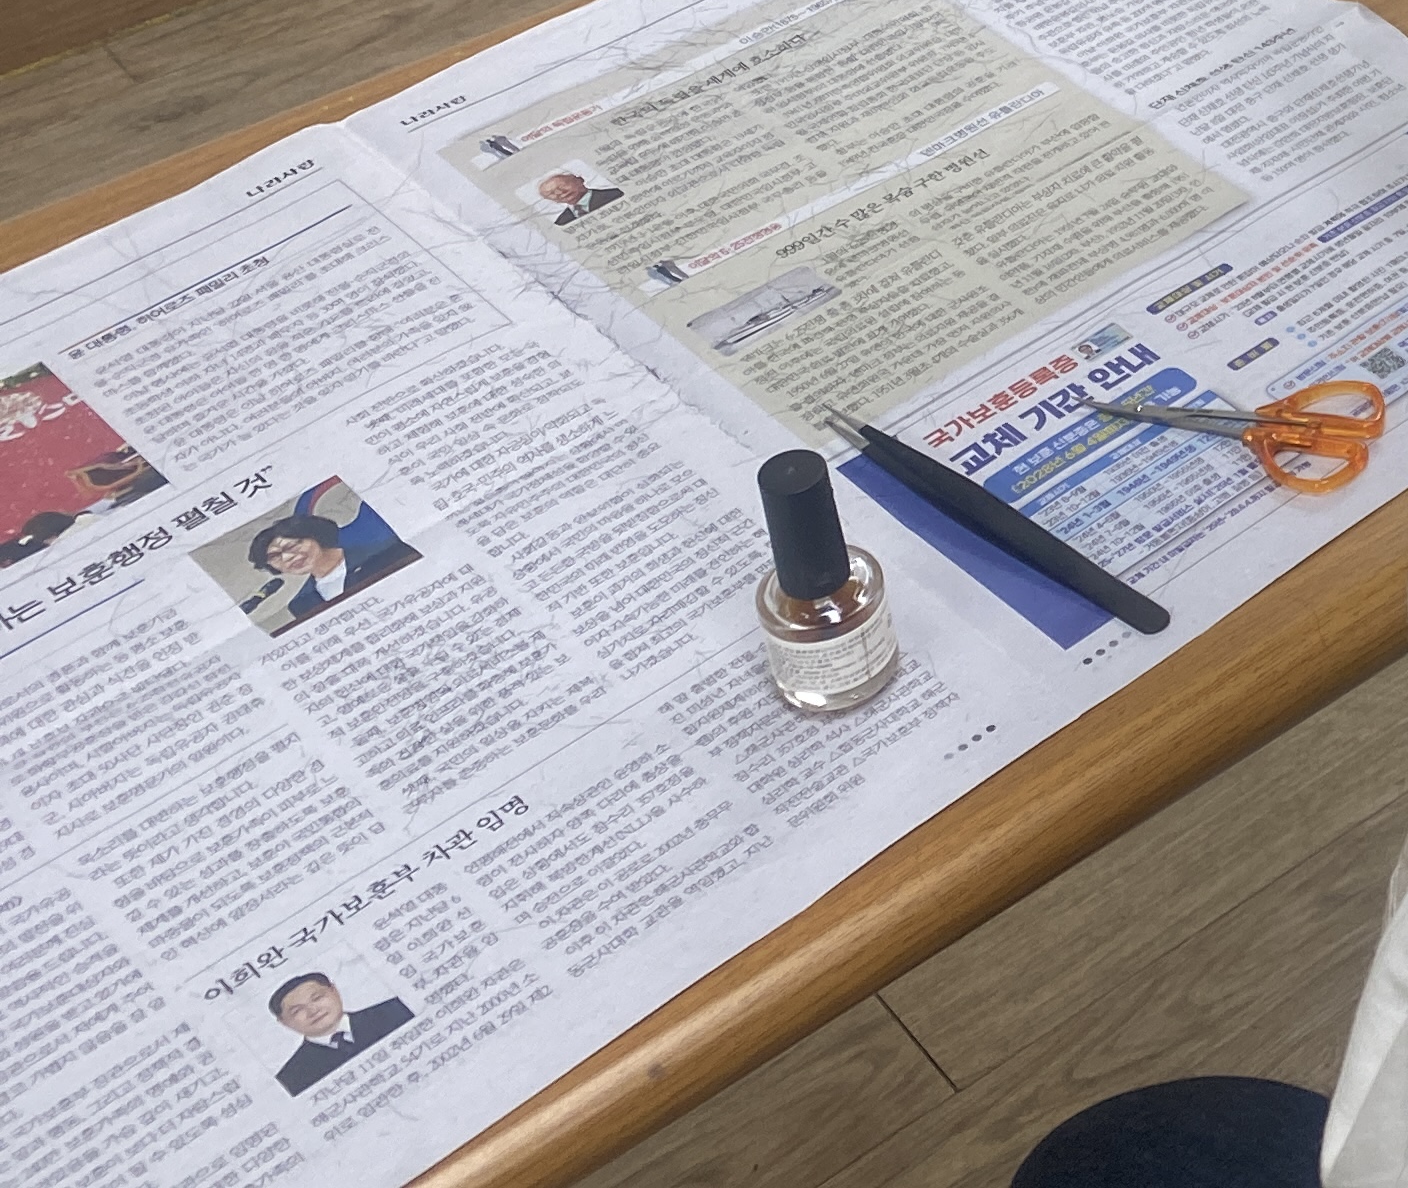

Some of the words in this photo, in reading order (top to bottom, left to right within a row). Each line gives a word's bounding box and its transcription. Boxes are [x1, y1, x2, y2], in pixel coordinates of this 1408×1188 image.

[246, 158, 316, 198] 나라사랑
[776, 226, 835, 258] 999일간
[851, 203, 883, 221] 많은
[914, 170, 945, 188] 구한
[136, 294, 195, 324] 히어로즈
[195, 272, 239, 296] 패밀리
[925, 356, 1077, 447] 국가보훈등록증
[950, 424, 1026, 475] 교체
[1020, 384, 1093, 430] 기간
[1088, 344, 1159, 390] 안내
[1086, 418, 1130, 445] 4일까지
[47, 526, 173, 603] 보훈행정
[171, 491, 239, 531] 펼칠
[205, 946, 287, 1000] 이희완
[290, 865, 418, 946] 국가보훈부
[423, 829, 477, 866] 차관
[477, 796, 529, 831] 임명
